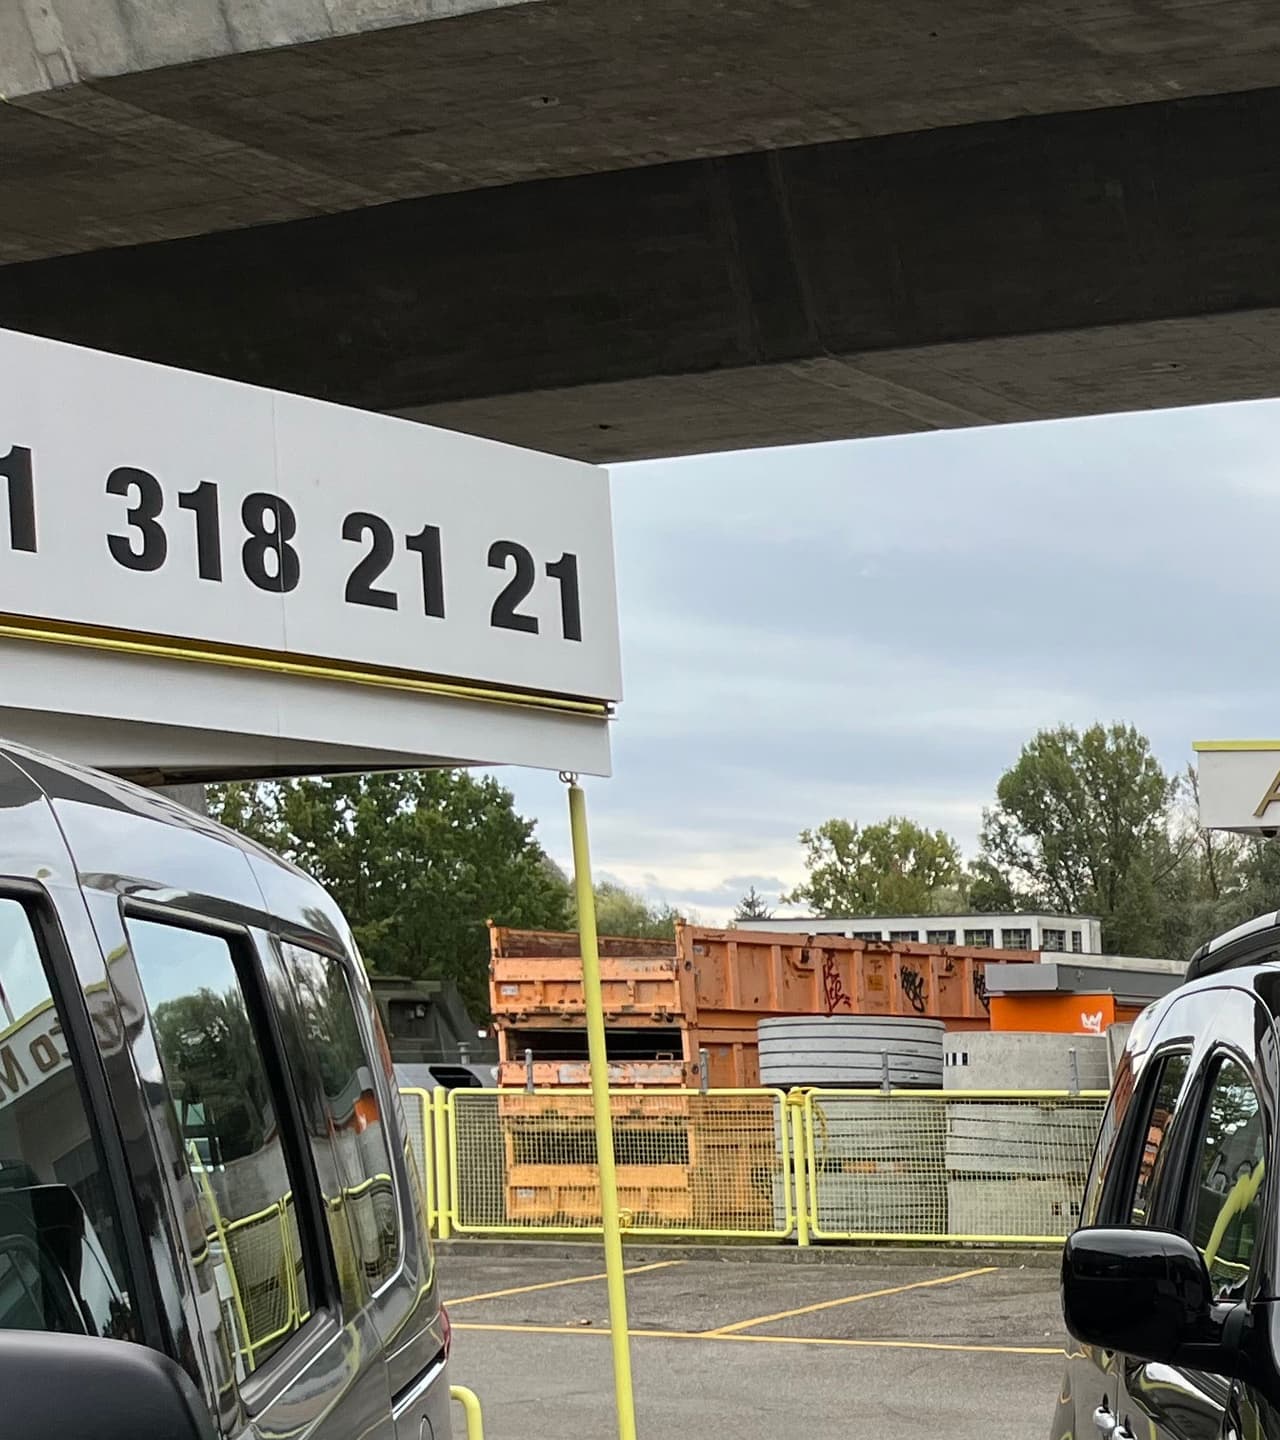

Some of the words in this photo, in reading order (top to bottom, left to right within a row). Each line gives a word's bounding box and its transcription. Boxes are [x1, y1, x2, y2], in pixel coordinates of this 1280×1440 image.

[105, 466, 301, 593] 318
[342, 512, 446, 618] 21
[487, 540, 582, 642] 21
